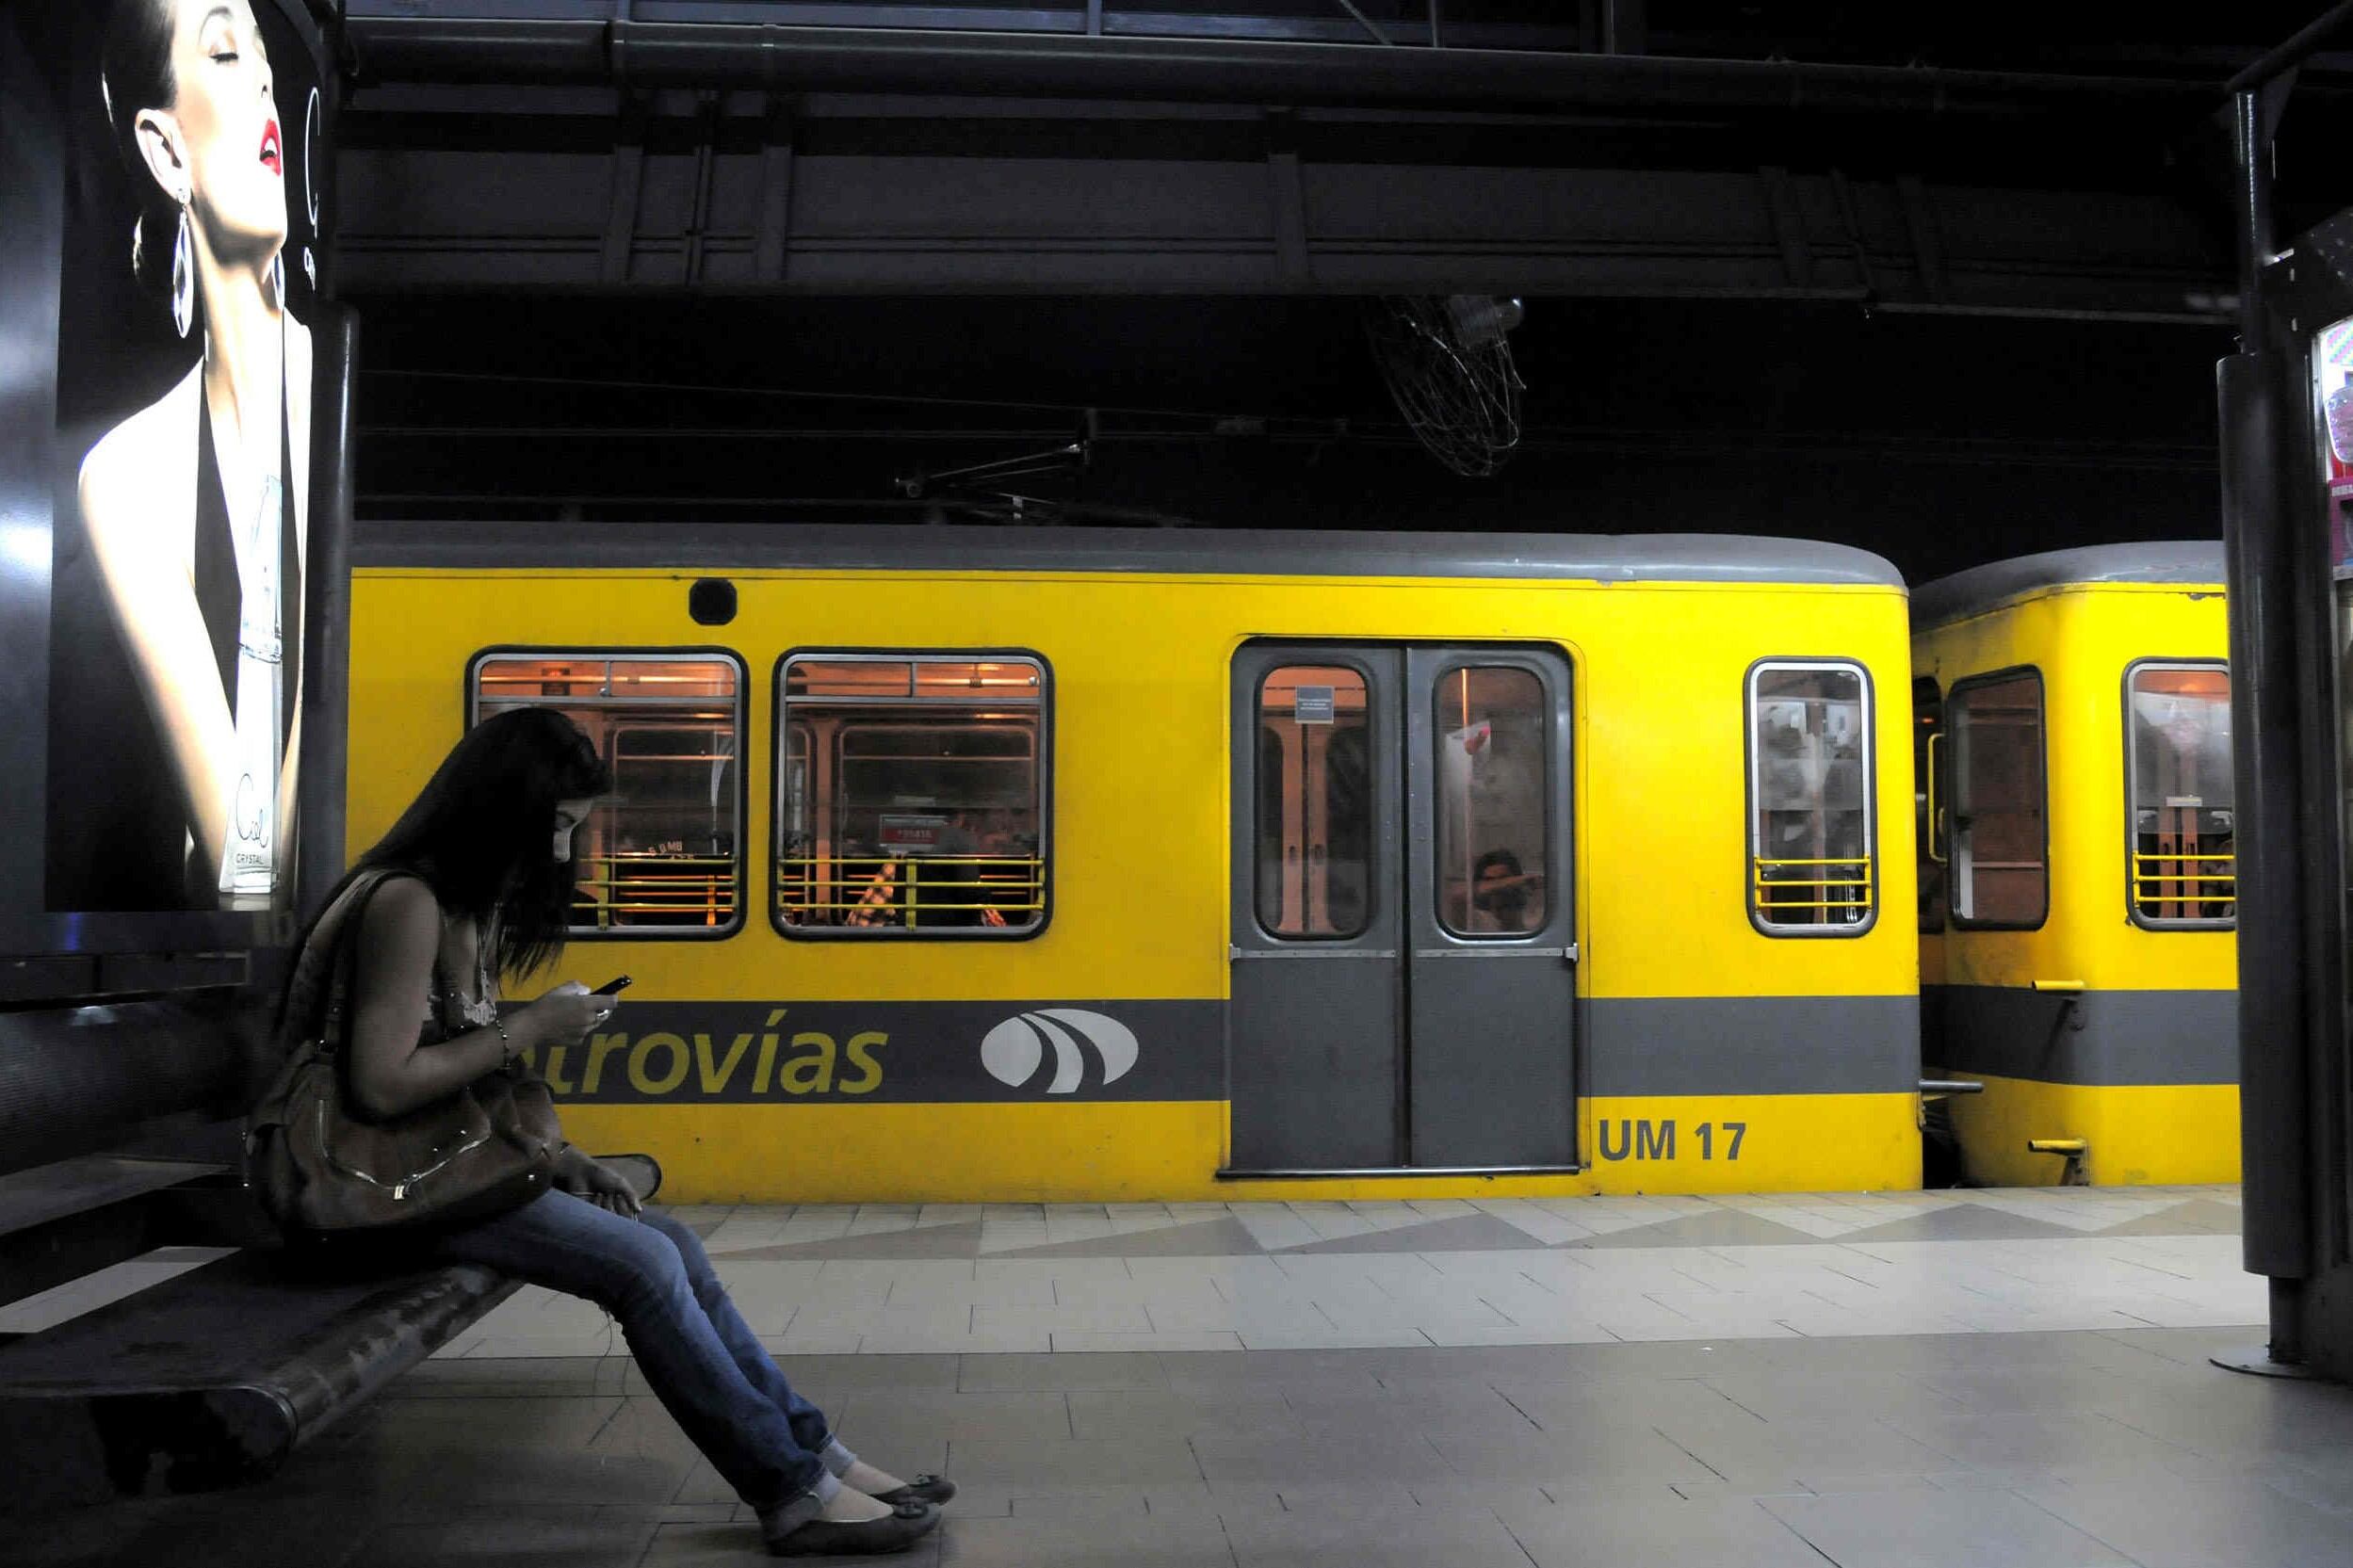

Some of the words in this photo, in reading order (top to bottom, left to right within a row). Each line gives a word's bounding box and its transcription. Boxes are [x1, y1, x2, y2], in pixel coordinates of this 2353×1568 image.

[235, 853, 265, 865] CRYSTAL
[521, 1009, 888, 1094] trovías
[1598, 1119, 1676, 1161] UM
[1694, 1123, 1746, 1160] 17
